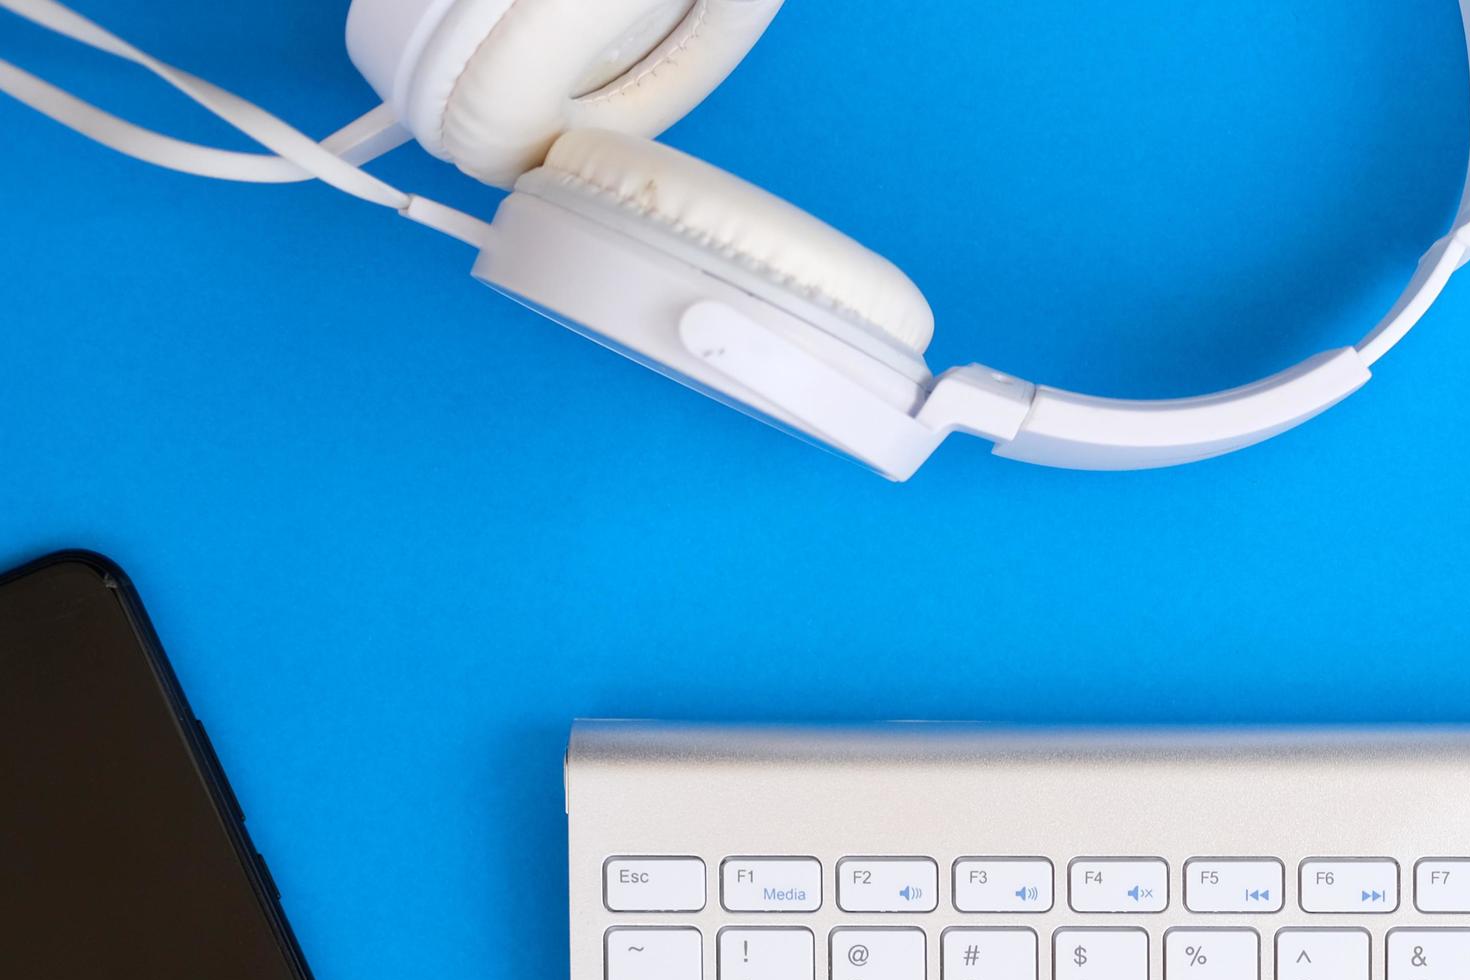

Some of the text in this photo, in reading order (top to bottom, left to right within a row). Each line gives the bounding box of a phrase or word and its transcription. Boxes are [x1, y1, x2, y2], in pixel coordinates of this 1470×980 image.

[620, 870, 648, 883] Esc
[738, 870, 753, 883] F1
[854, 871, 871, 884] F2
[970, 871, 987, 884] F3
[1085, 871, 1103, 884] F4
[1201, 871, 1218, 884] F5
[1317, 872, 1334, 885] F6
[1432, 871, 1450, 884] F7
[764, 888, 805, 900] Media
[848, 945, 869, 966] @
[964, 945, 980, 966] #
[1074, 945, 1087, 967] $
[1185, 946, 1207, 966] %
[1411, 946, 1427, 967] &
